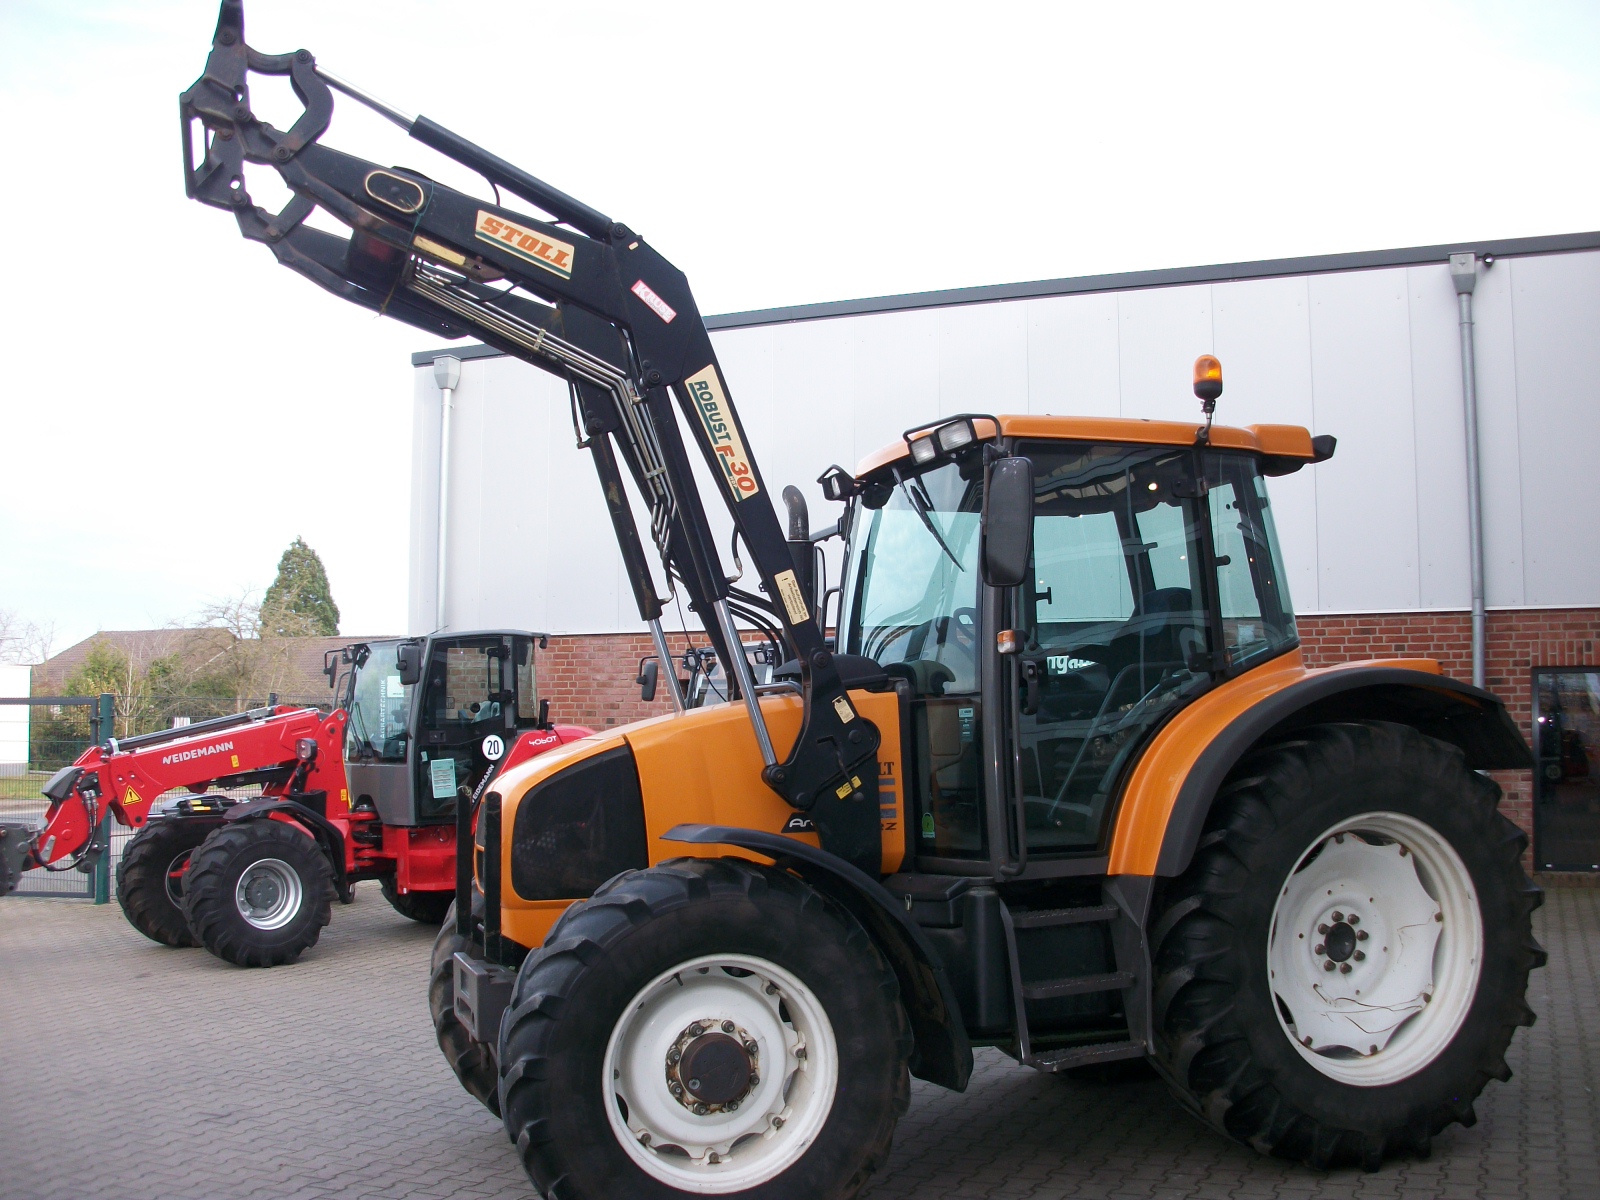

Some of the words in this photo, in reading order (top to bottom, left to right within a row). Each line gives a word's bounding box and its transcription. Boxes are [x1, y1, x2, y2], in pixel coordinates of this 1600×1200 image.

[480, 217, 570, 268] STOLL
[694, 380, 732, 441] ROBUST
[715, 445, 735, 457] F
[730, 461, 755, 492] 30
[487, 740, 500, 756] 20
